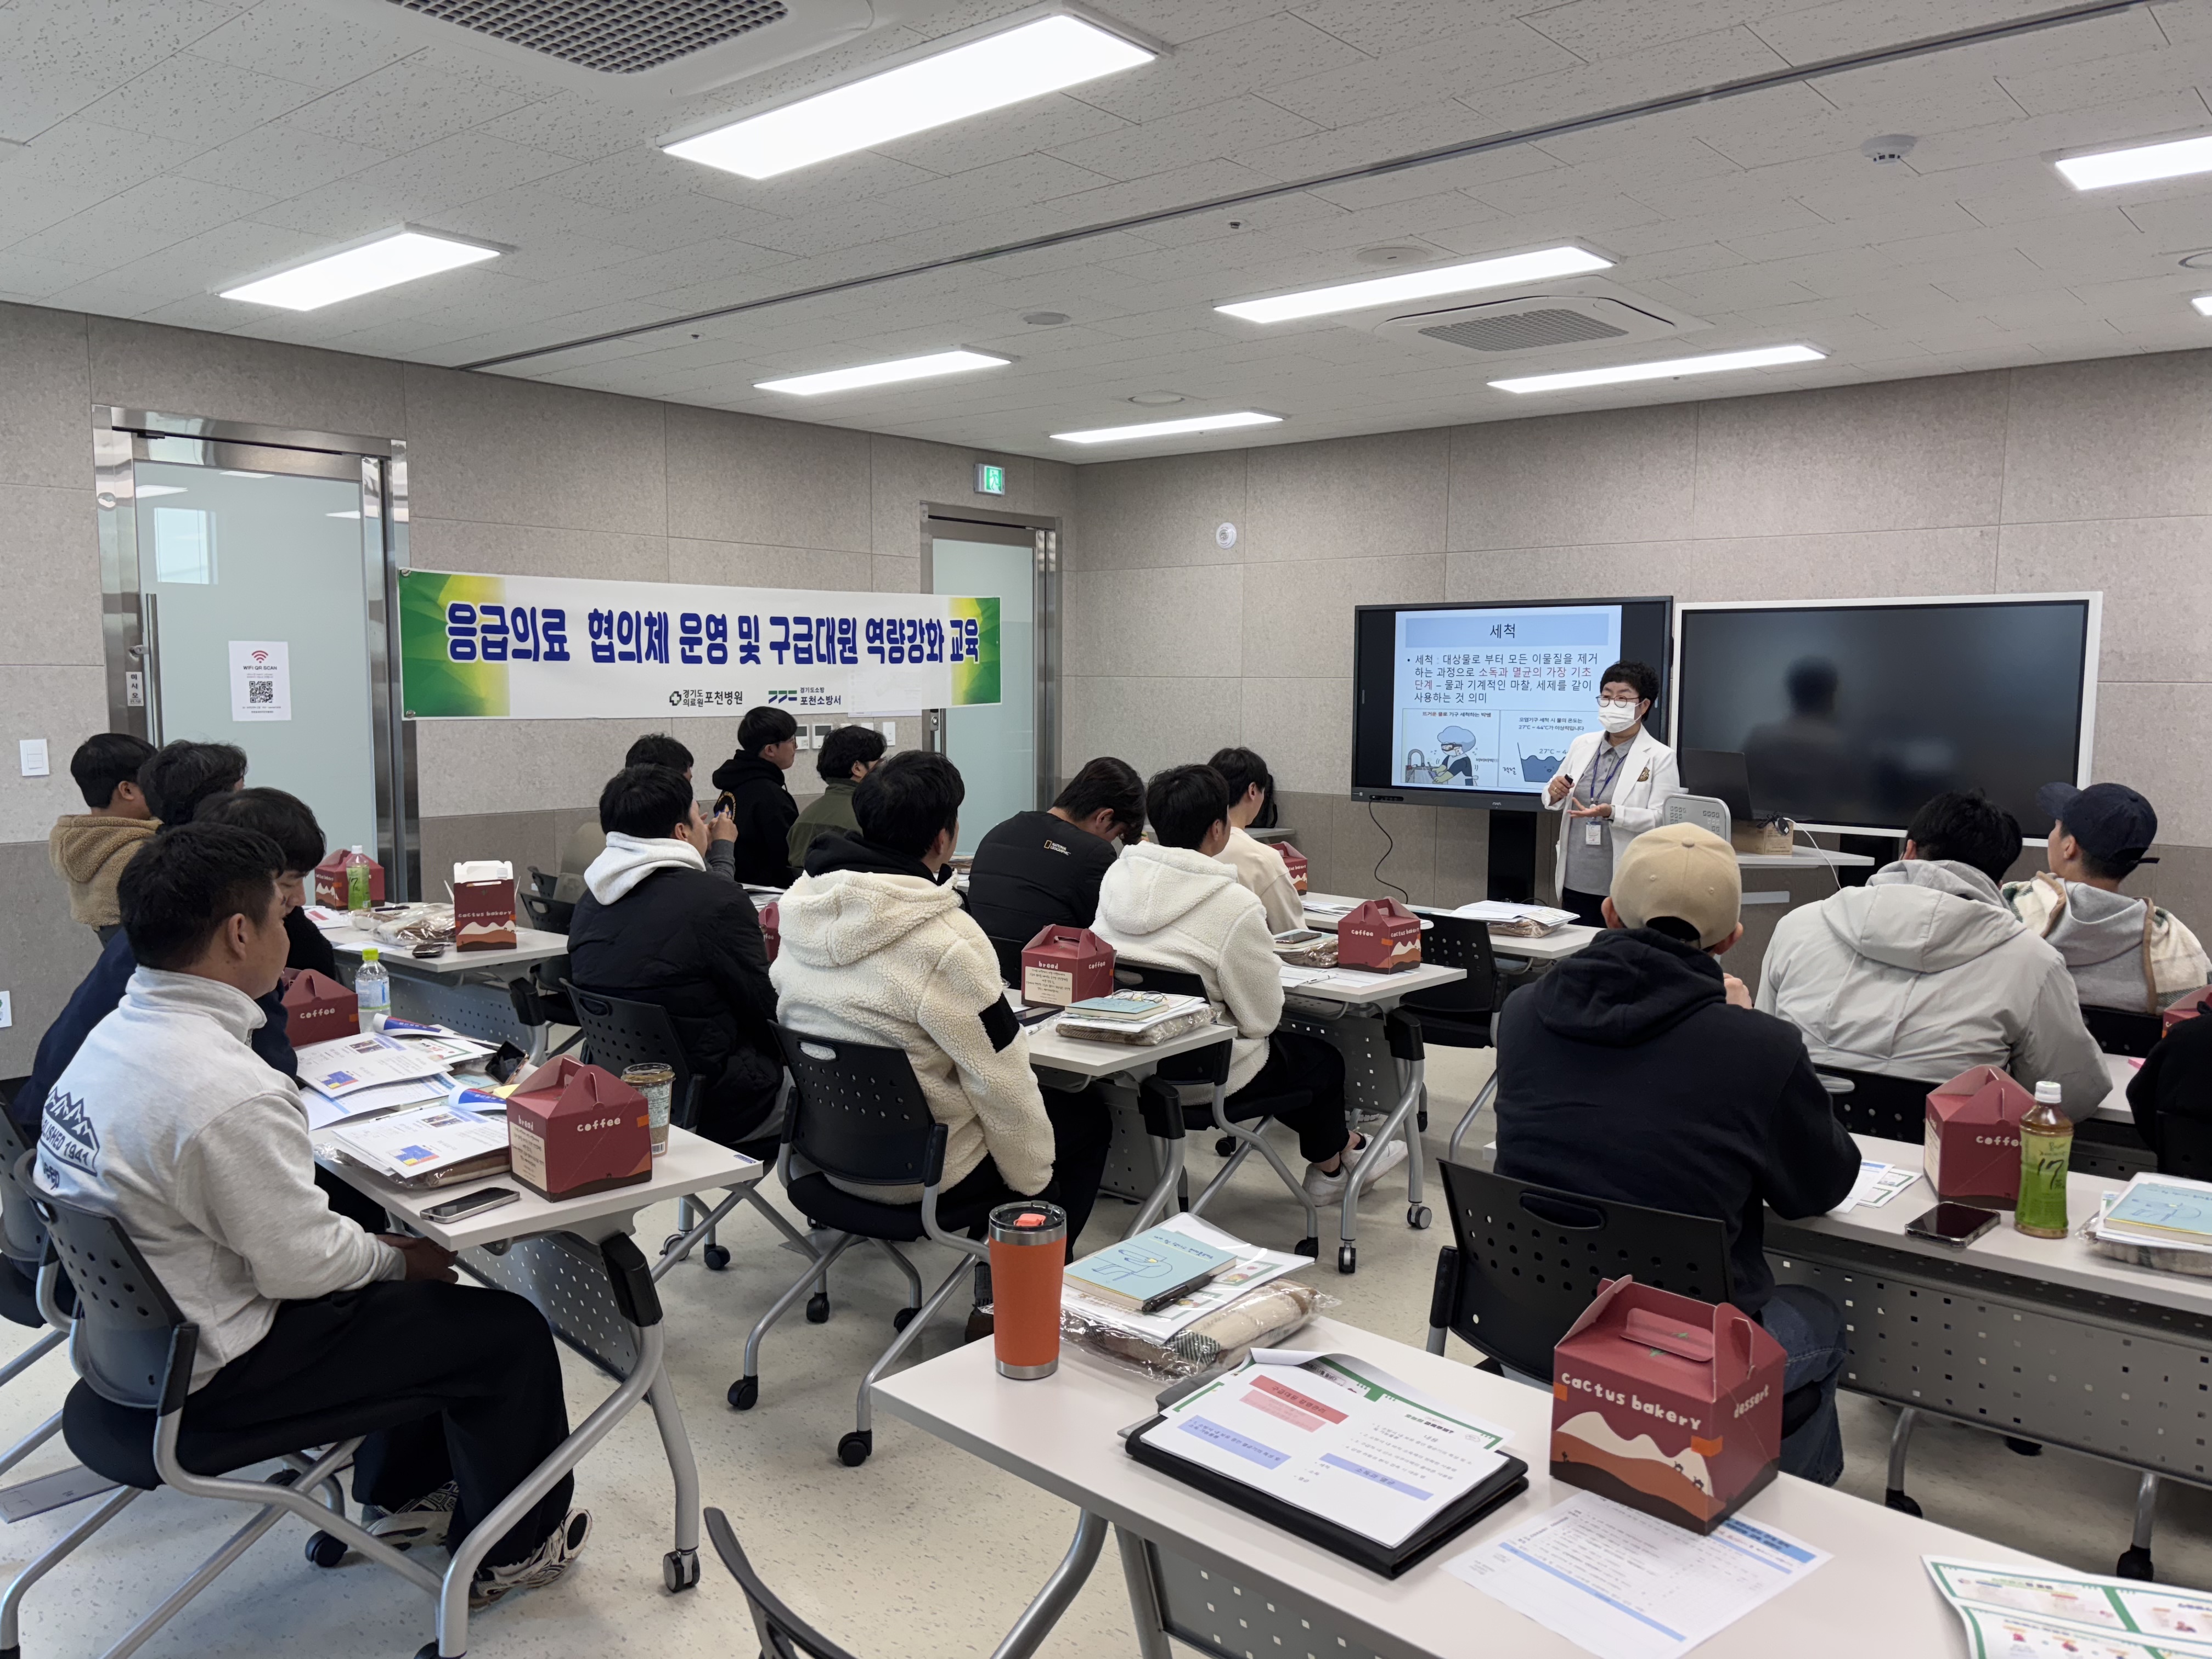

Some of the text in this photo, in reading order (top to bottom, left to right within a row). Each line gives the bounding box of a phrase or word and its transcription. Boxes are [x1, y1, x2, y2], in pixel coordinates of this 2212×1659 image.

[448, 603, 979, 664] 응급의료 협의체 운영 및 구급대원 역량강화 교육
[1490, 624, 1515, 639] 세척
[1415, 654, 1432, 665] 세척
[1443, 654, 1481, 665] 대상물로
[1485, 654, 1504, 665] 부터
[1508, 654, 1528, 664] 모든
[1532, 653, 1573, 664] 이물질을
[1577, 653, 1597, 664] 제거
[1415, 667, 1592, 678] 하는 과정으로 소독과 멸균의 가장 기초
[1415, 680, 1432, 691] 단계
[1445, 680, 1464, 691] 물과
[1468, 680, 1505, 691] 기계적인
[1510, 680, 1532, 691] 마찰,
[1537, 680, 1567, 691] 세제를
[1571, 680, 1592, 691] 같이
[682, 689, 703, 698] 경기도
[704, 691, 743, 705] 포천병원
[1414, 692, 1487, 703] 사용하는 것 의미
[682, 698, 703, 707] 의료원
[800, 695, 841, 706] 포천소방서
[1039, 960, 1058, 970] bread
[1088, 961, 1106, 969] coffee
[300, 1008, 335, 1019] coffee
[518, 1114, 534, 1131] bread
[577, 1117, 621, 1132] coffee
[63, 1141, 89, 1166] 1941
[2037, 1158, 2064, 1190] 17
[1561, 1373, 1702, 1430] cactus bakery
[1734, 1384, 1770, 1419] dessert
